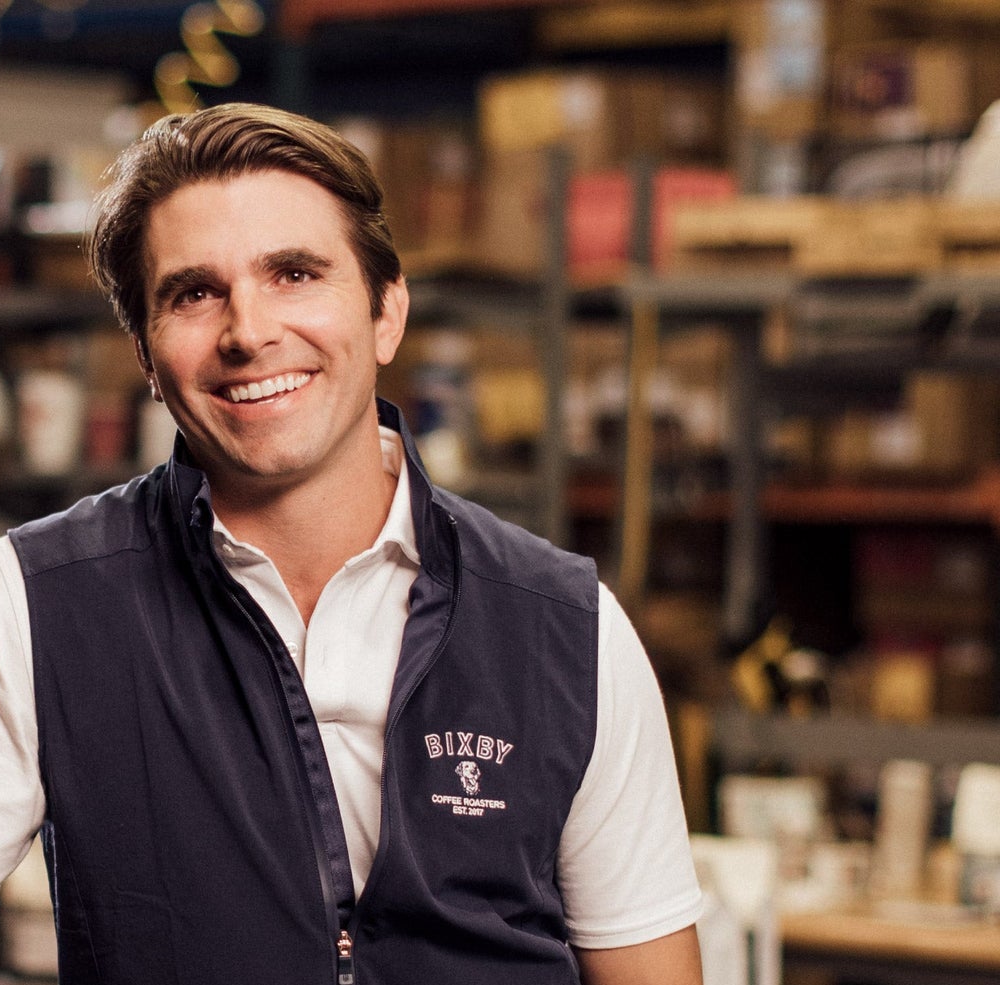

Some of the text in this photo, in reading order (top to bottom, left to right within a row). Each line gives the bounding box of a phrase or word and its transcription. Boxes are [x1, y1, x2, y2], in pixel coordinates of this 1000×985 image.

[424, 731, 514, 764] BIXBY
[431, 794, 506, 809] COFFEE ROASTERS
[452, 805, 484, 816] EST. 2017
